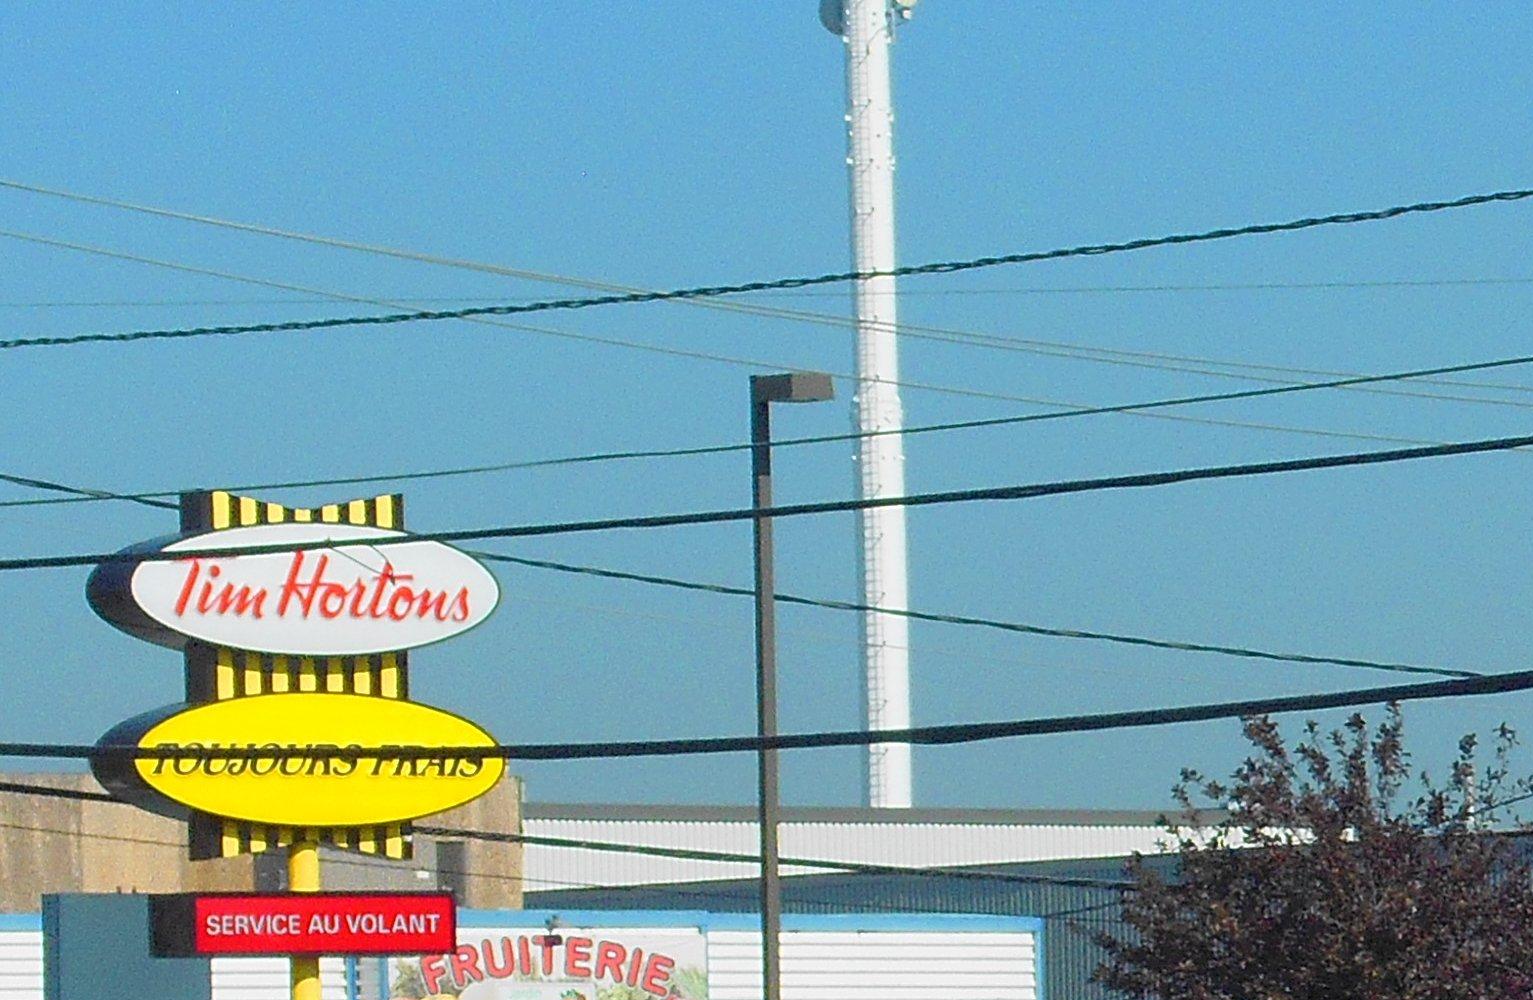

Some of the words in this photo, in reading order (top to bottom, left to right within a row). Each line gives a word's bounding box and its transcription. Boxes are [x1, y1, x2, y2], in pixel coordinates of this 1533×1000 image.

[172, 556, 268, 618] Tim
[279, 549, 471, 622] Hortons
[153, 743, 363, 777] TOUJOURS
[369, 744, 485, 778] FRAIS
[206, 914, 301, 936] SERVICE
[308, 913, 341, 935] AU
[346, 913, 441, 934] VOLANT
[420, 933, 676, 998] FRUITERIE
